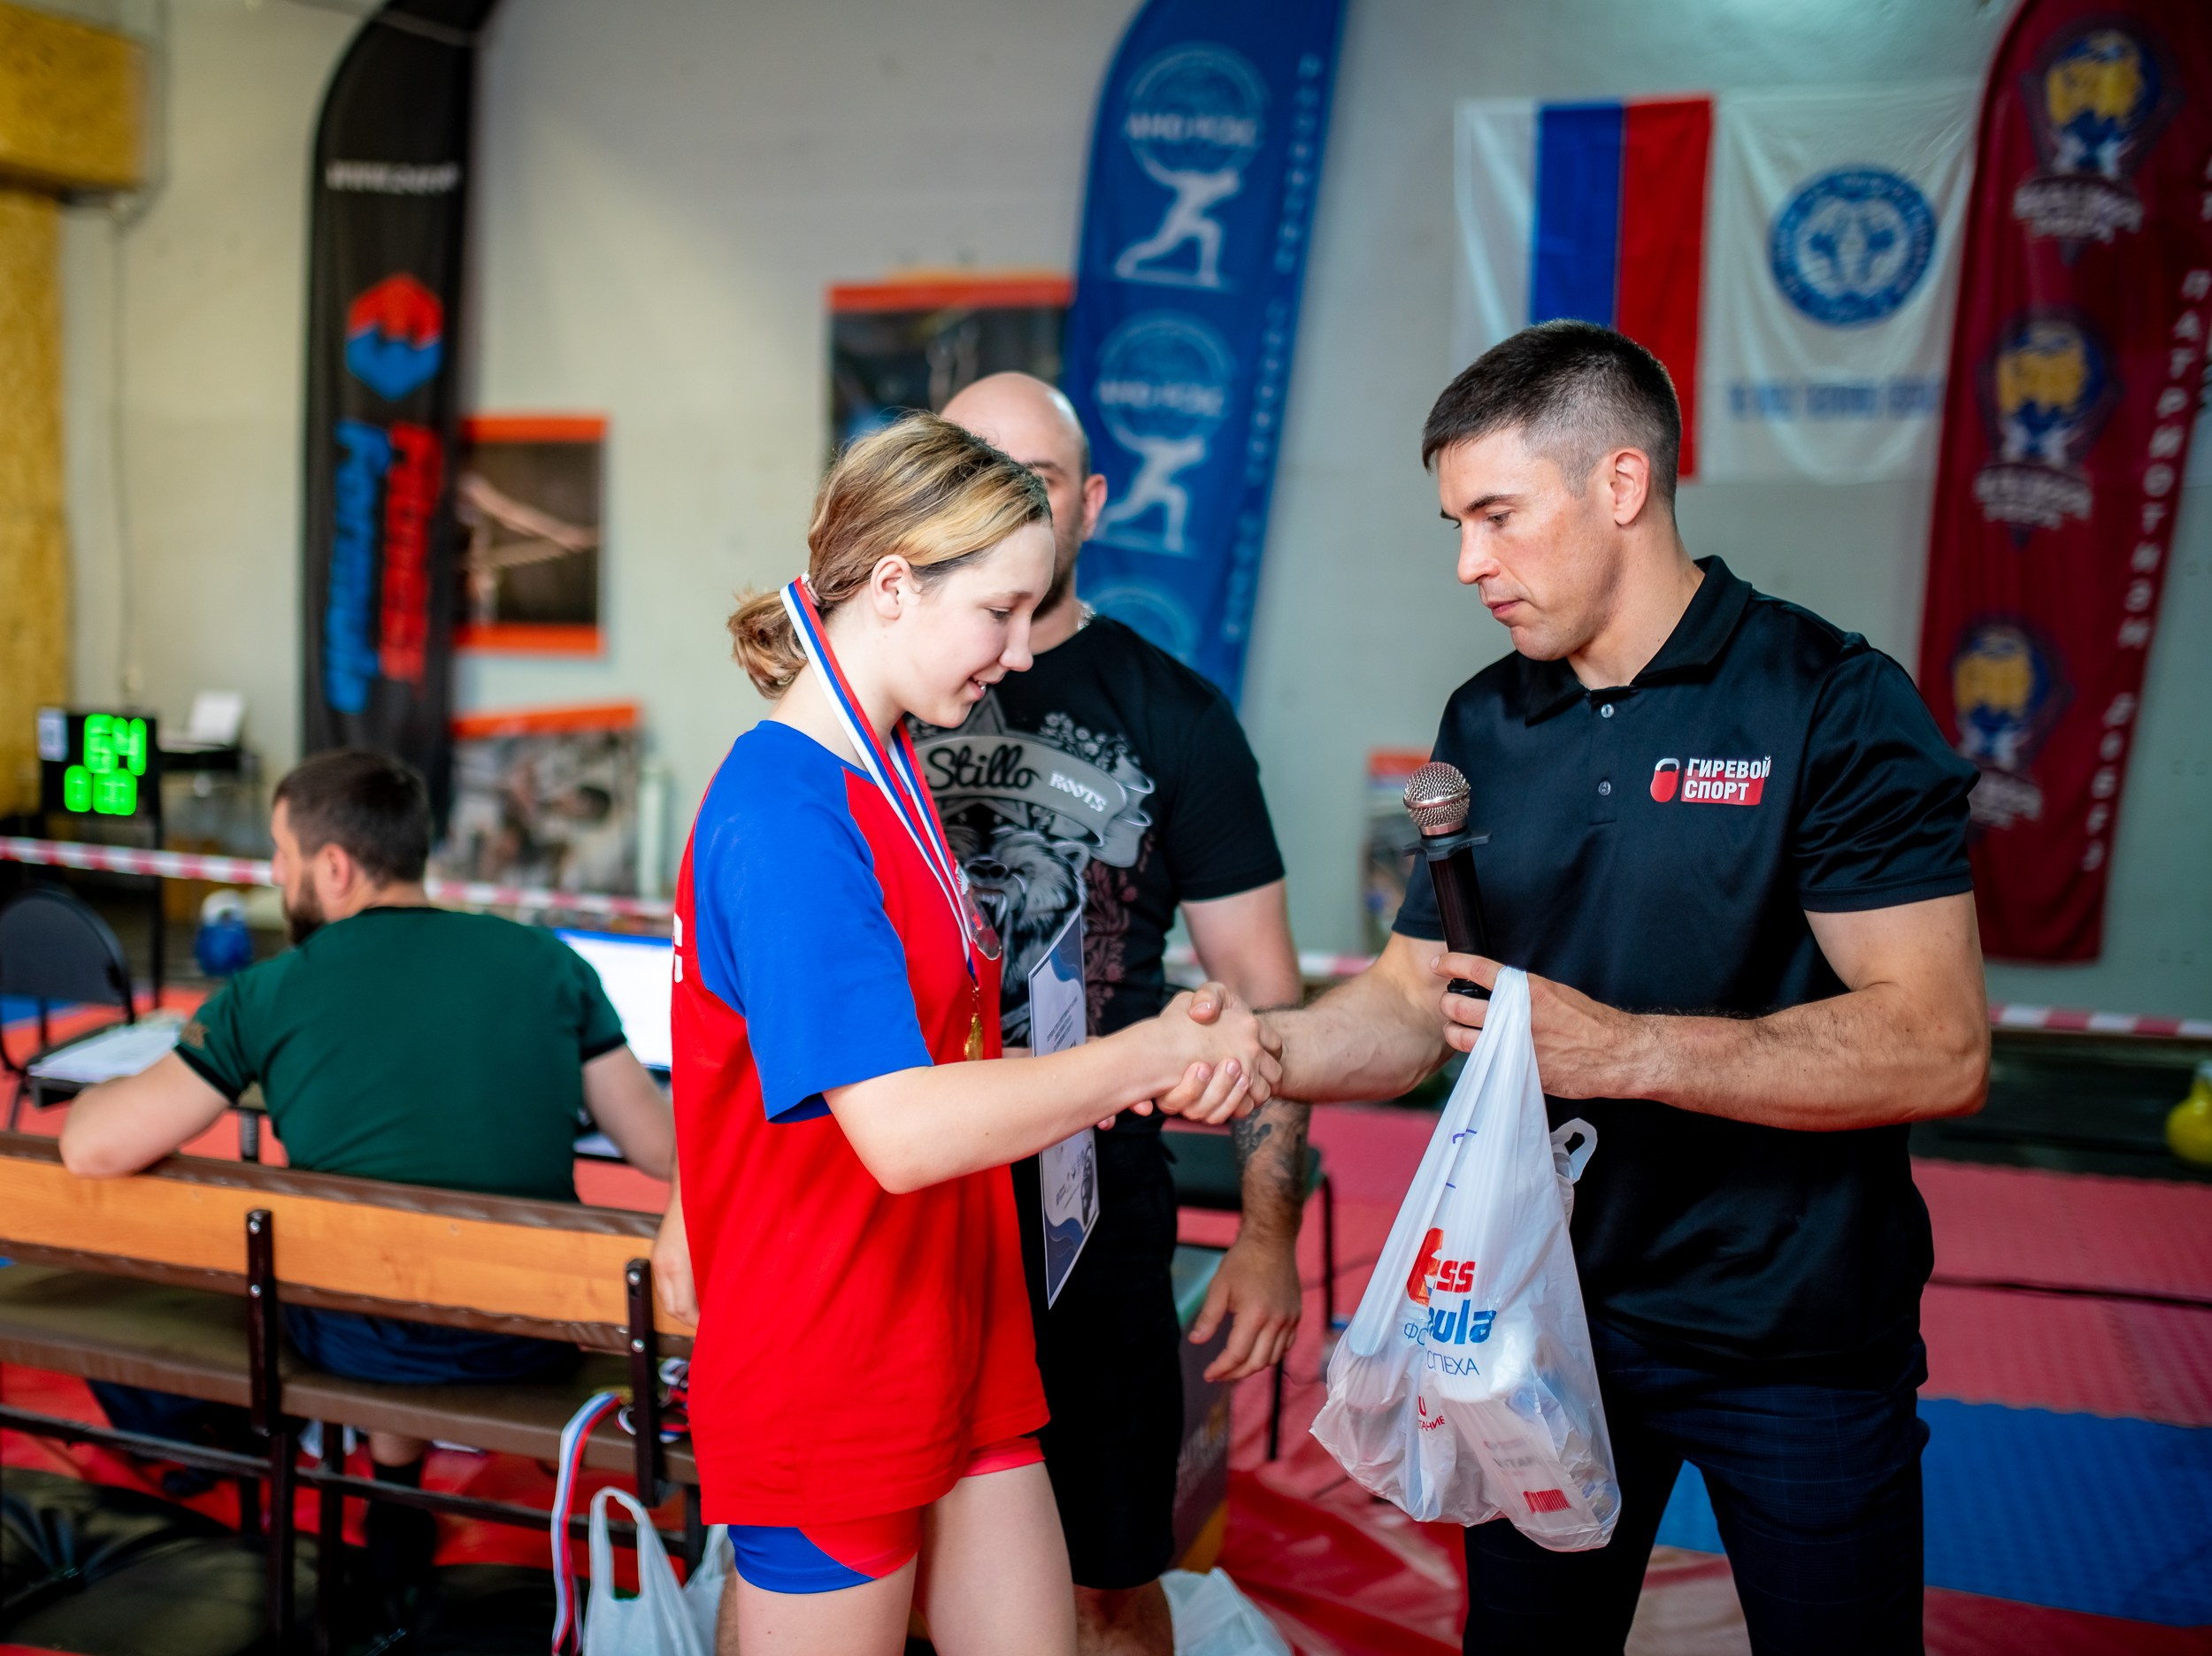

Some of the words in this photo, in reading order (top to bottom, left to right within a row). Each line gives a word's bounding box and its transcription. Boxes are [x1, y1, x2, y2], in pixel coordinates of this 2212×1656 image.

[84, 714, 147, 776] 64
[926, 744, 1041, 791] Stillo
[1686, 755, 1772, 780] ГИРЕВОЙ
[1684, 779, 1750, 801] СПОРТ
[1425, 1349, 1481, 1376] СПЕХА
